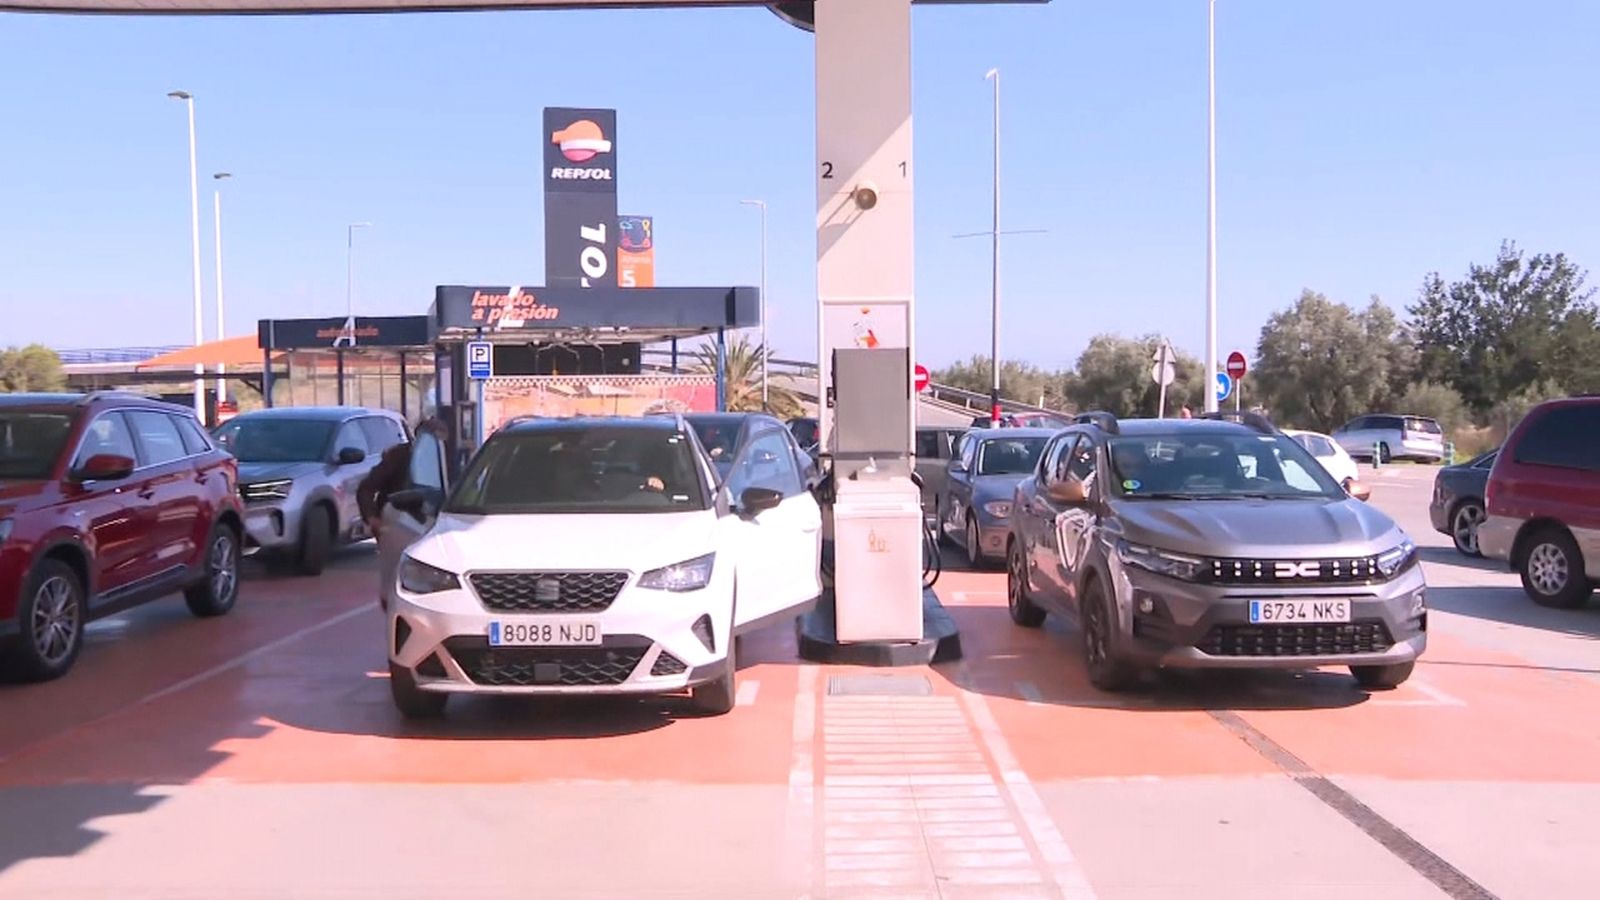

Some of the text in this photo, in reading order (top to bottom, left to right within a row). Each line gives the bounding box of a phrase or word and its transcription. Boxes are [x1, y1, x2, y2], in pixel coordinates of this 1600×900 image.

[551, 168, 612, 180] REPSOL
[821, 162, 834, 179] 2
[898, 161, 907, 178] 1
[580, 223, 607, 287] OL
[471, 290, 534, 307] lavado
[471, 304, 559, 324] a presión
[475, 348, 486, 361] P
[1263, 603, 1346, 620] 6734 NKS
[504, 625, 596, 642] 8088 NJD
